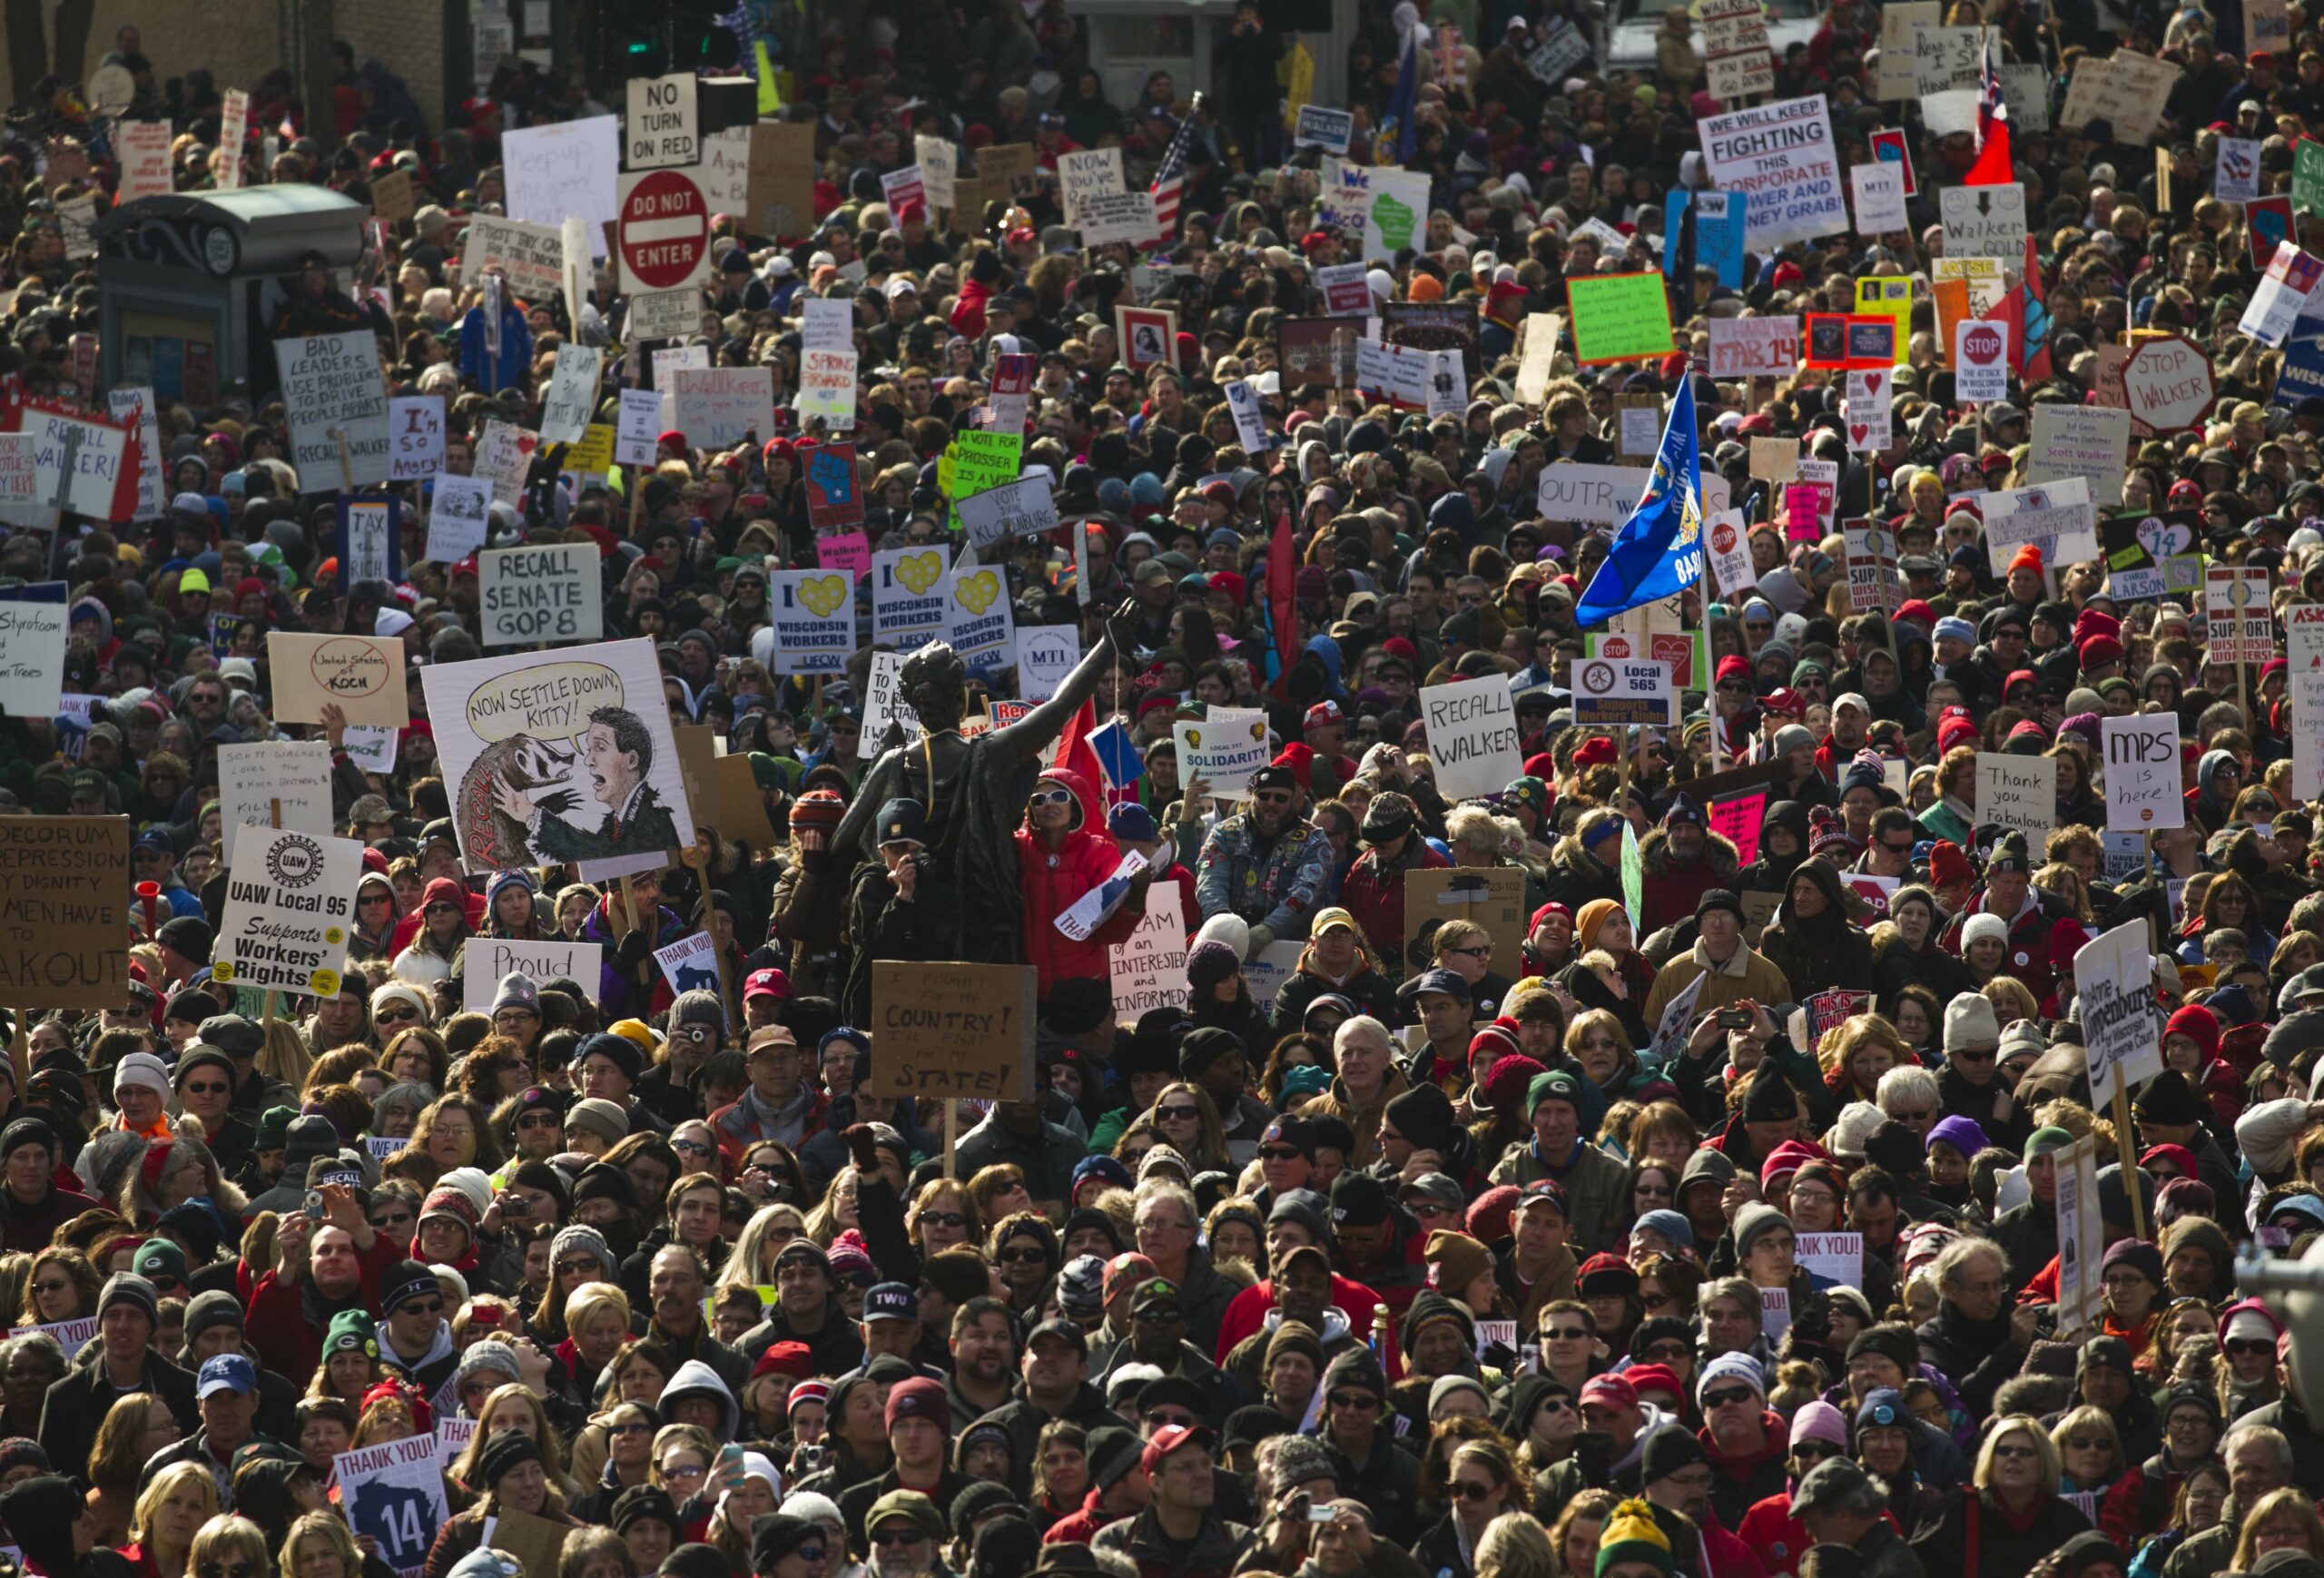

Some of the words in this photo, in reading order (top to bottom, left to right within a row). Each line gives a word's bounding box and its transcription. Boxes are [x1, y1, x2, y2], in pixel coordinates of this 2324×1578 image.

[646, 83, 678, 106] NO
[642, 112, 682, 132] TURN
[1708, 116, 1734, 133] WE
[1737, 110, 1772, 128] WILL
[1778, 100, 1819, 120] KEEP
[634, 141, 655, 158] ON
[662, 136, 694, 154] RED
[1712, 121, 1825, 161] FIGHTING
[1068, 148, 1112, 171] NOW
[1754, 154, 1789, 172] THIS
[1793, 179, 1832, 199] AND
[634, 195, 655, 214] DO
[661, 192, 693, 212] NOT
[1787, 195, 1844, 221] GRAB!
[636, 244, 693, 267] ENTER
[1330, 285, 1367, 300] WRONG
[1341, 297, 1360, 308] WAY
[306, 338, 342, 357] BAD
[1714, 340, 1764, 371] FAB
[1766, 338, 1797, 369] 14
[1966, 338, 2000, 353] STOP
[290, 356, 367, 376] LEADERS
[2137, 350, 2187, 375] STOP
[1964, 369, 1975, 377] THE
[1977, 369, 2001, 377] ATTACK
[285, 378, 315, 397] USE
[1959, 380, 1968, 388] ON
[1969, 380, 2004, 388] WISCONSIN
[2137, 377, 2206, 410] WALKER
[296, 395, 314, 408] TO
[319, 386, 365, 404] DRIVE
[1967, 390, 1996, 398] FAMILIES
[290, 407, 340, 428] PEOPLE
[2079, 410, 2117, 420] McCarthy
[46, 418, 105, 448] REALL
[960, 433, 968, 443] A
[971, 434, 994, 446] VOTE
[1000, 436, 1018, 448] FOR
[348, 439, 390, 457] WALKER
[2047, 449, 2073, 458] Scott
[2076, 449, 2113, 460] Walker
[393, 456, 445, 477] Angry!
[957, 449, 1010, 469] PROSSER
[1804, 463, 1837, 472] WALKER'S
[2034, 459, 2069, 468] Welcome
[956, 469, 974, 480] IS
[990, 487, 1020, 506] VOTE
[352, 512, 384, 533] TAX
[1713, 531, 1734, 548] STOP
[2151, 531, 2176, 557] 14
[822, 545, 864, 557] Walker:
[1724, 551, 1744, 565] ATTACK
[498, 551, 578, 580] RECALL
[882, 564, 891, 588] I
[2123, 572, 2149, 581] CHRIS
[486, 582, 582, 610] SENATE
[783, 585, 793, 607] I
[2112, 578, 2167, 599] LARSON
[877, 597, 944, 614] WISCONSIN
[0, 610, 61, 636] Styrofoam
[497, 610, 551, 635] GOP
[556, 609, 576, 634] 8
[777, 621, 848, 633] WISCONSIN
[879, 612, 941, 628] WORKERS
[781, 634, 847, 647] WORKERS
[969, 651, 1002, 668] UFCW
[1032, 649, 1065, 663] MTI
[1604, 645, 1629, 656] STOP
[314, 655, 346, 666] United
[350, 656, 385, 666] States
[340, 665, 354, 675] of
[803, 655, 841, 667] UFCW
[12, 663, 43, 678] Trees
[1624, 666, 1660, 677] Local
[329, 677, 368, 690] KOCH
[875, 674, 889, 687] TO
[1630, 679, 1657, 691] 565
[471, 695, 507, 721] NOW
[509, 677, 570, 710] SETTLE
[572, 673, 619, 697] DOWN,
[873, 691, 886, 705] TO
[1596, 698, 1649, 711] Supports
[527, 700, 579, 729] KITTY!
[1430, 692, 1511, 728] RECALL
[1631, 711, 1668, 724] Rights
[62, 734, 84, 761] 14
[344, 744, 382, 757] AFSCME
[1187, 746, 1266, 767] SOLIDARITY
[1433, 727, 1520, 767] WALKER
[226, 751, 266, 763] SCOTT
[275, 751, 324, 759] WALKER
[1228, 764, 1261, 777] ENGINEERS
[1986, 767, 2042, 790] Thank
[2137, 768, 2152, 783] is
[1993, 791, 2021, 804] you
[2119, 782, 2171, 805] here!
[467, 764, 499, 865] RECALL
[1715, 800, 1760, 818] Walker:
[1987, 808, 2049, 830] Fabulous
[282, 854, 308, 869] UAW
[23, 874, 102, 893] DIGNITY
[231, 881, 271, 905] UAW
[275, 888, 322, 913] Local
[326, 895, 348, 916] 95
[62, 902, 112, 925] HAVE
[7, 926, 34, 942] TO
[243, 916, 321, 942] Supports
[235, 937, 328, 967] Workers'
[658, 943, 692, 965] THANK
[692, 934, 714, 955] YOU!
[1135, 938, 1152, 950] an
[493, 945, 572, 980] Proud
[1112, 952, 1187, 976] INTERESTED
[1256, 966, 1275, 976] part
[232, 961, 316, 988] Rights!
[922, 973, 993, 987] FOUGHT
[1134, 975, 1156, 987] and
[1113, 989, 1187, 1012] INFORMED
[1814, 994, 1837, 1015] THIS
[1840, 992, 1853, 1008] IS
[885, 1004, 1012, 1035] COUNTRY!
[1817, 1011, 1849, 1034] WHAT
[2112, 1018, 2146, 1042] Wisconsin
[2107, 1040, 2134, 1063] Supreme
[2134, 1031, 2155, 1050] Court
[895, 1064, 1011, 1095] STATE!
[1550, 1080, 1571, 1093] G
[371, 1139, 389, 1156] WE
[323, 1173, 360, 1185] RECALL
[1825, 1236, 1859, 1255] YOU!
[875, 1292, 907, 1307] TWU
[1482, 1323, 1515, 1344] YOU!
[339, 1446, 395, 1476] THANK
[396, 1437, 434, 1463] YOU!
[380, 1499, 425, 1556] 14
